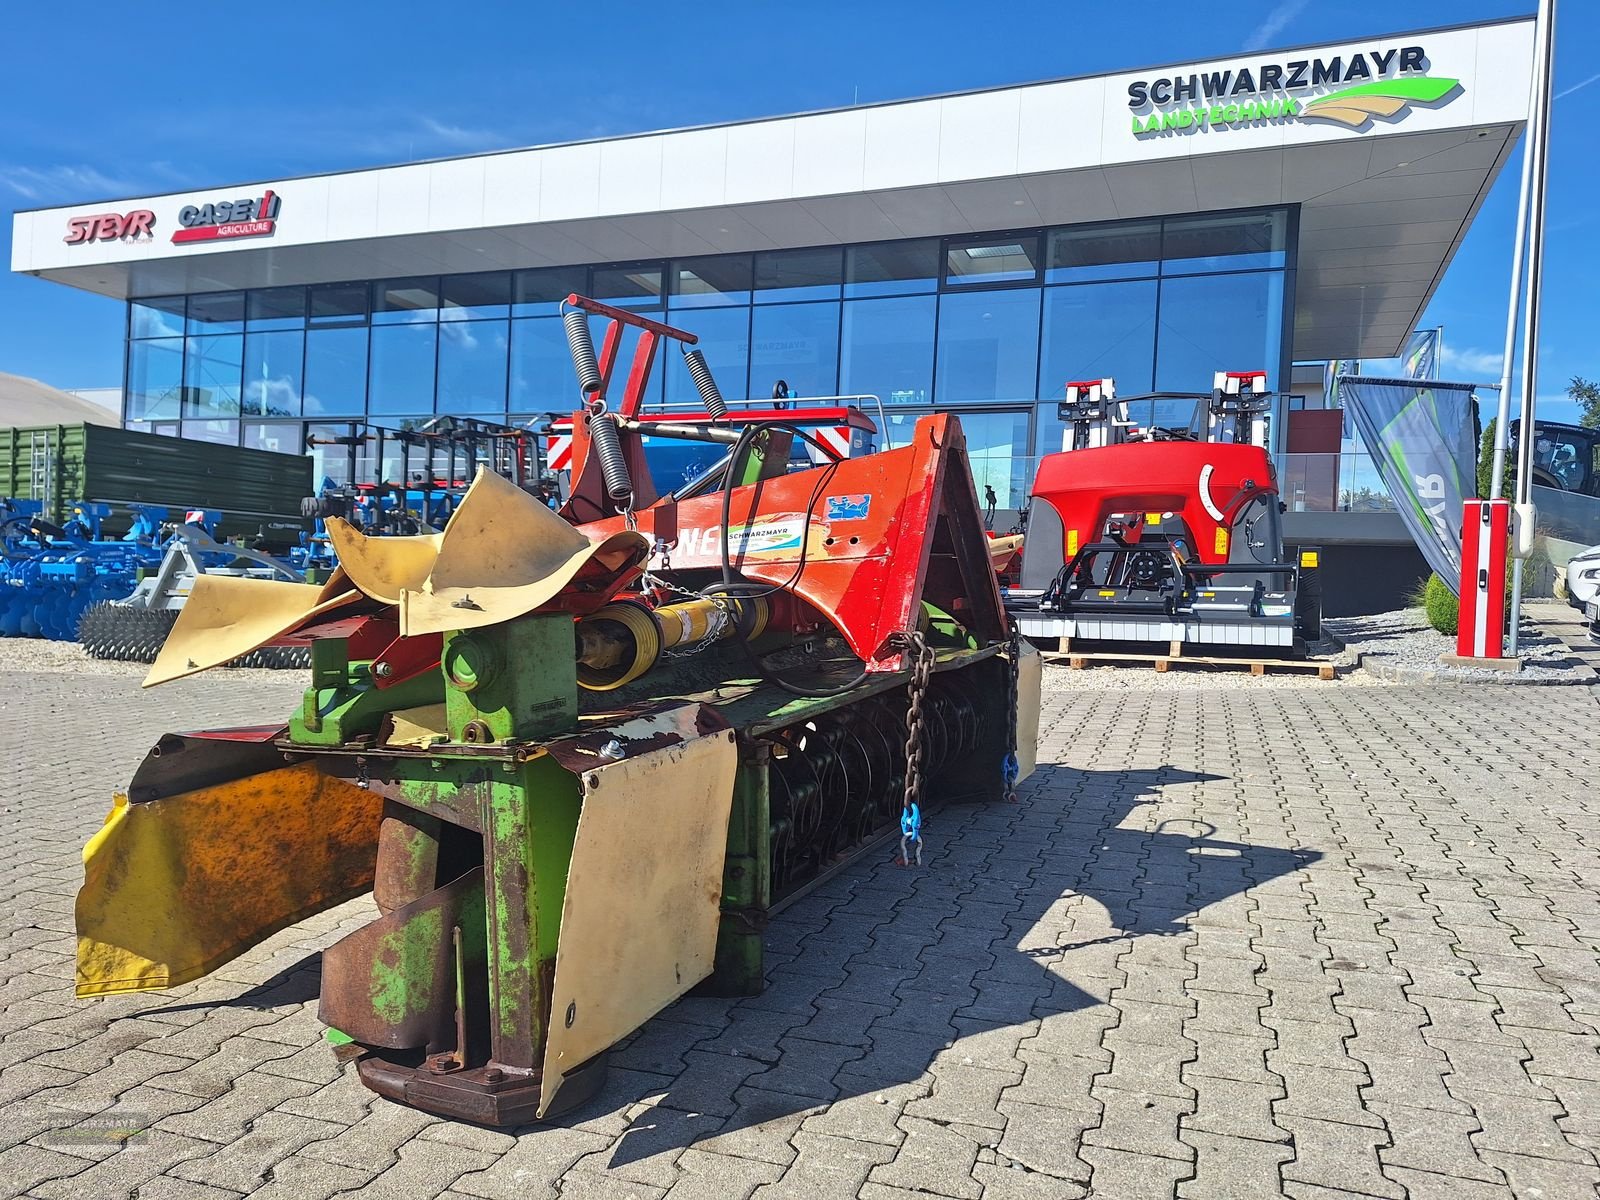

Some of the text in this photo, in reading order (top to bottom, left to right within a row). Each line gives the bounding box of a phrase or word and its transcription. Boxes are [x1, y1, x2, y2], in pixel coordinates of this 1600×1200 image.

[1128, 46, 1425, 106] SCHWARZMAYR
[1132, 98, 1298, 134] LANDTECHNIK
[63, 209, 156, 245] STEYR
[216, 221, 269, 236] AGRICULTURE
[729, 527, 788, 539] SCHWARZMAYR
